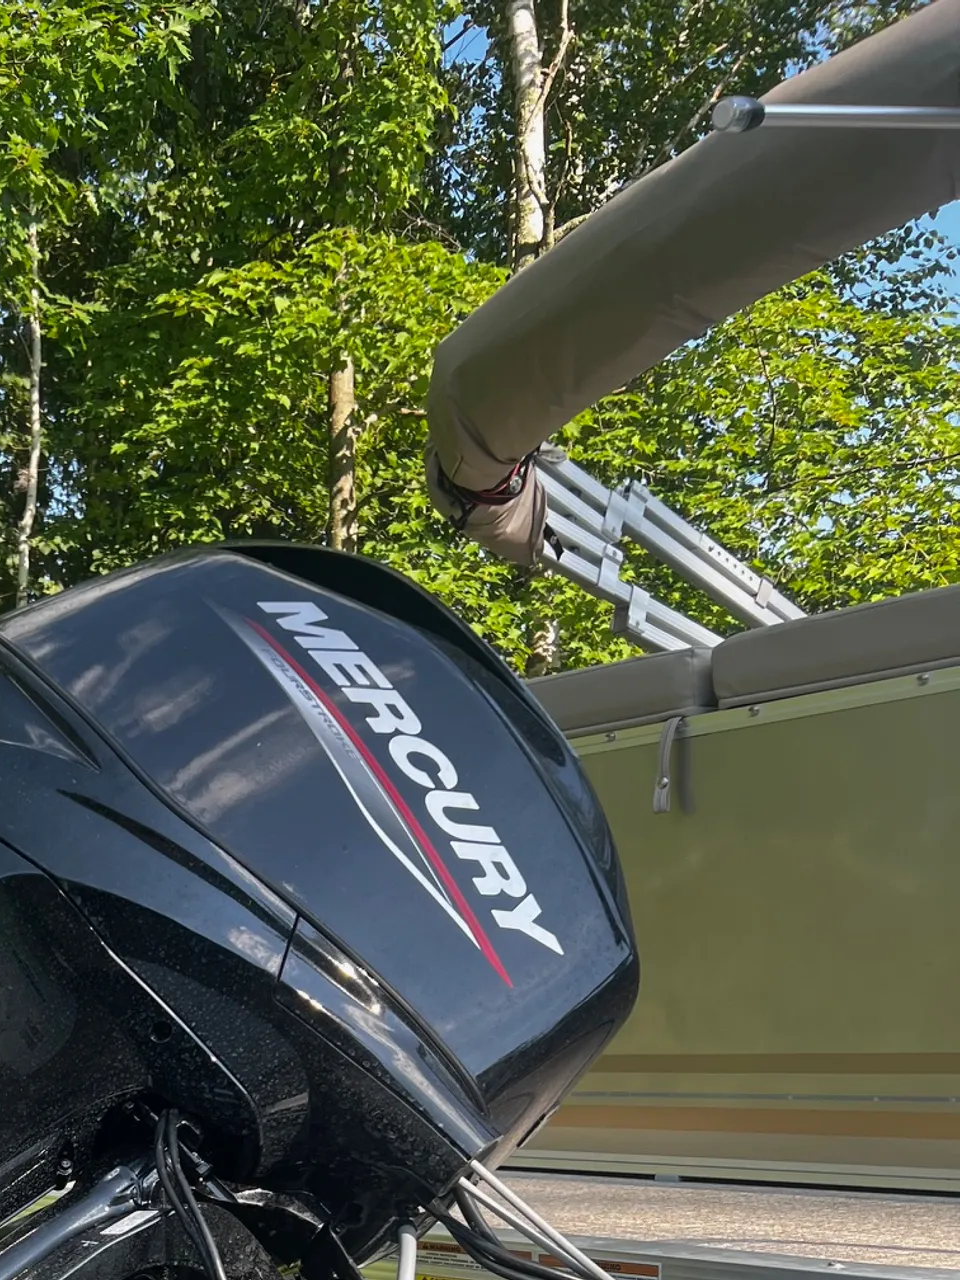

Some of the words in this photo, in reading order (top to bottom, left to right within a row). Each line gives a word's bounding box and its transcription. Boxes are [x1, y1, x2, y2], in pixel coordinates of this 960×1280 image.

[261, 647, 360, 760] FOURSTROKE
[256, 600, 565, 956] MERCURY
[430, 1243, 461, 1253] WARNING
